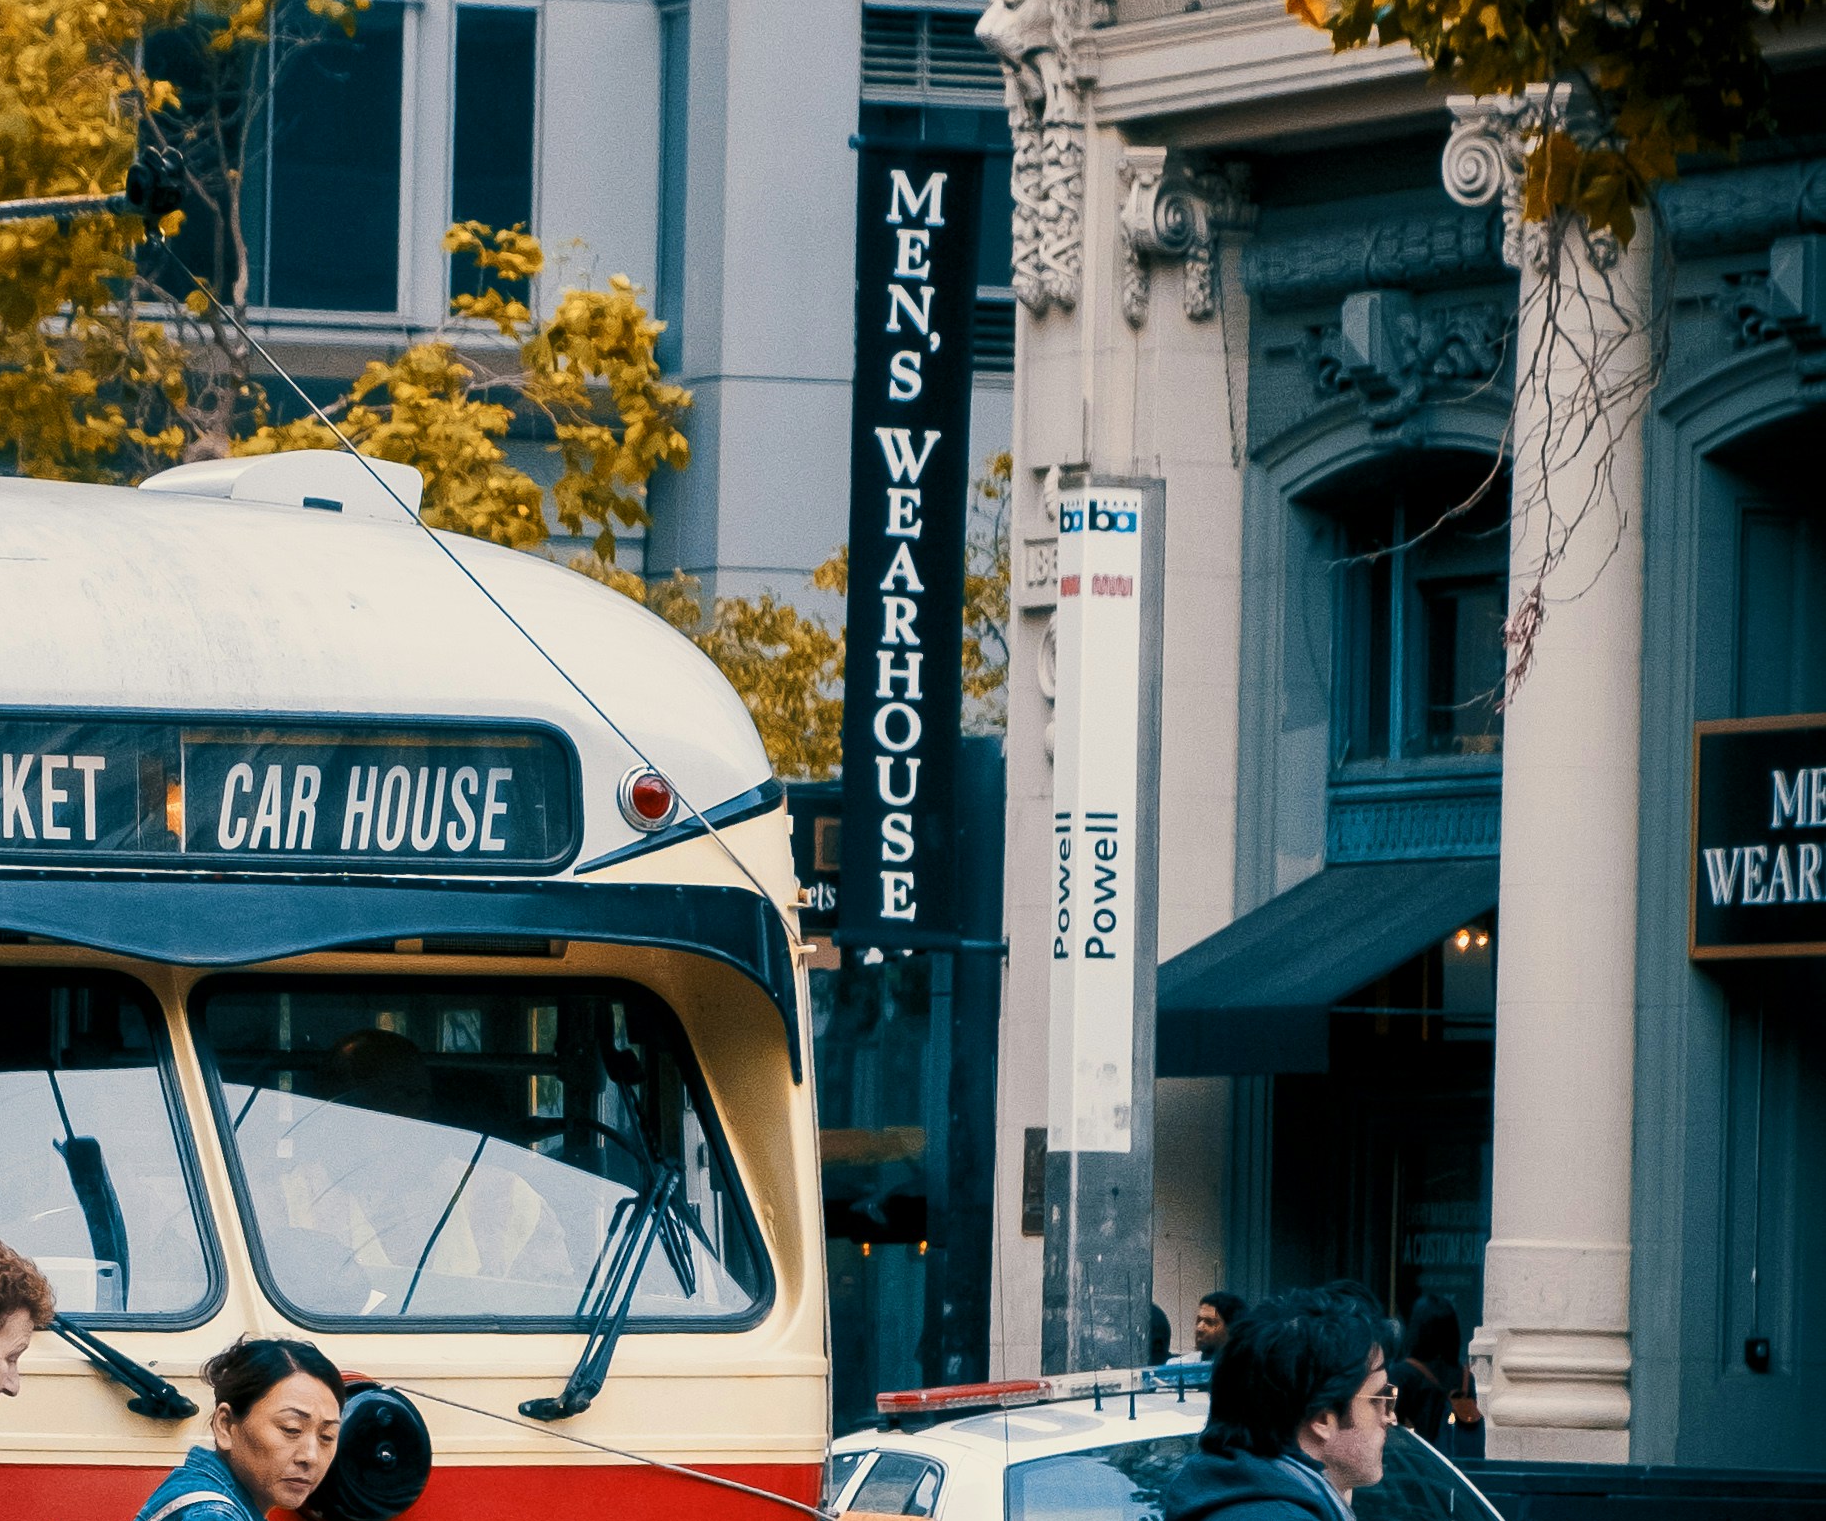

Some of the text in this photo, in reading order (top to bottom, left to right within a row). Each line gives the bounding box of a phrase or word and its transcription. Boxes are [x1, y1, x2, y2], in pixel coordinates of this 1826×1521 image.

[874, 169, 948, 921] MEN'S WEARHOUSE
[218, 762, 513, 852] CAR HOUSE
[1054, 811, 1072, 960] Powell
[1084, 812, 1118, 960] Powell
